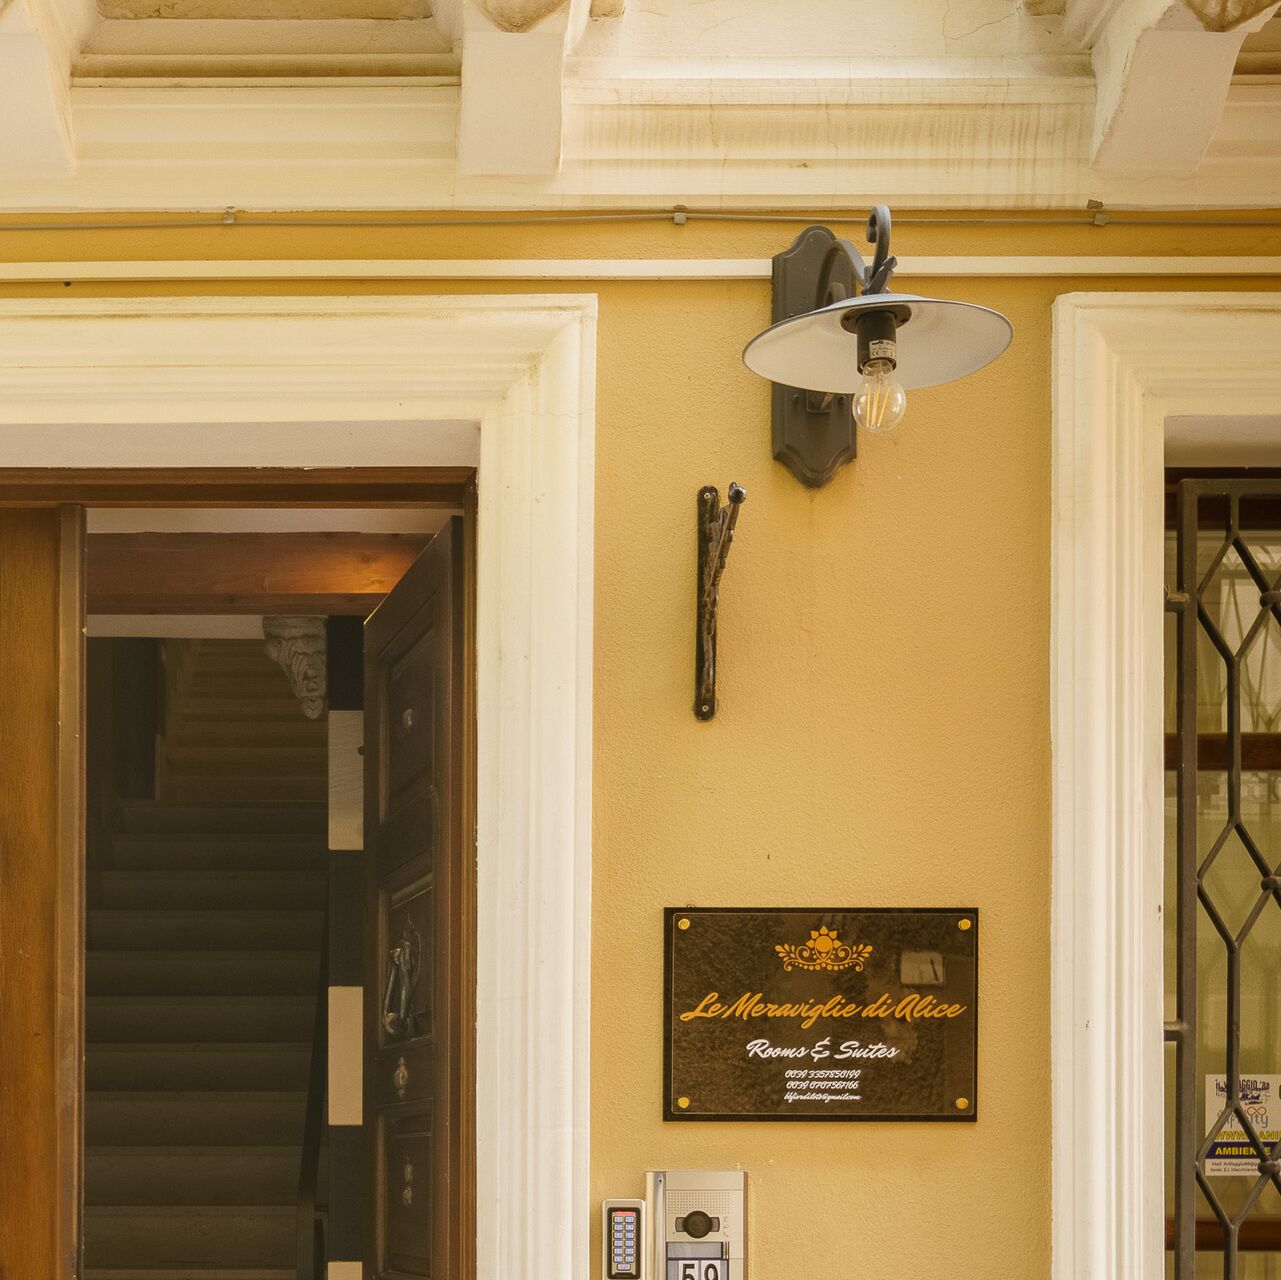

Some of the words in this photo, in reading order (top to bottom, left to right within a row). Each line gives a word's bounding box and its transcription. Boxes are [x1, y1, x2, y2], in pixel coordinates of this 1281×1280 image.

[679, 991, 728, 1022] Le
[721, 991, 862, 1030] Meraviglie
[861, 993, 896, 1018] di
[894, 993, 967, 1023] Alice
[745, 1038, 809, 1059] Rooms
[810, 1036, 830, 1063] &
[833, 1040, 900, 1059] Suites
[784, 1069, 808, 1079] 0039
[786, 1080, 810, 1090] 0039
[1215, 1146, 1272, 1156] AMBIENE
